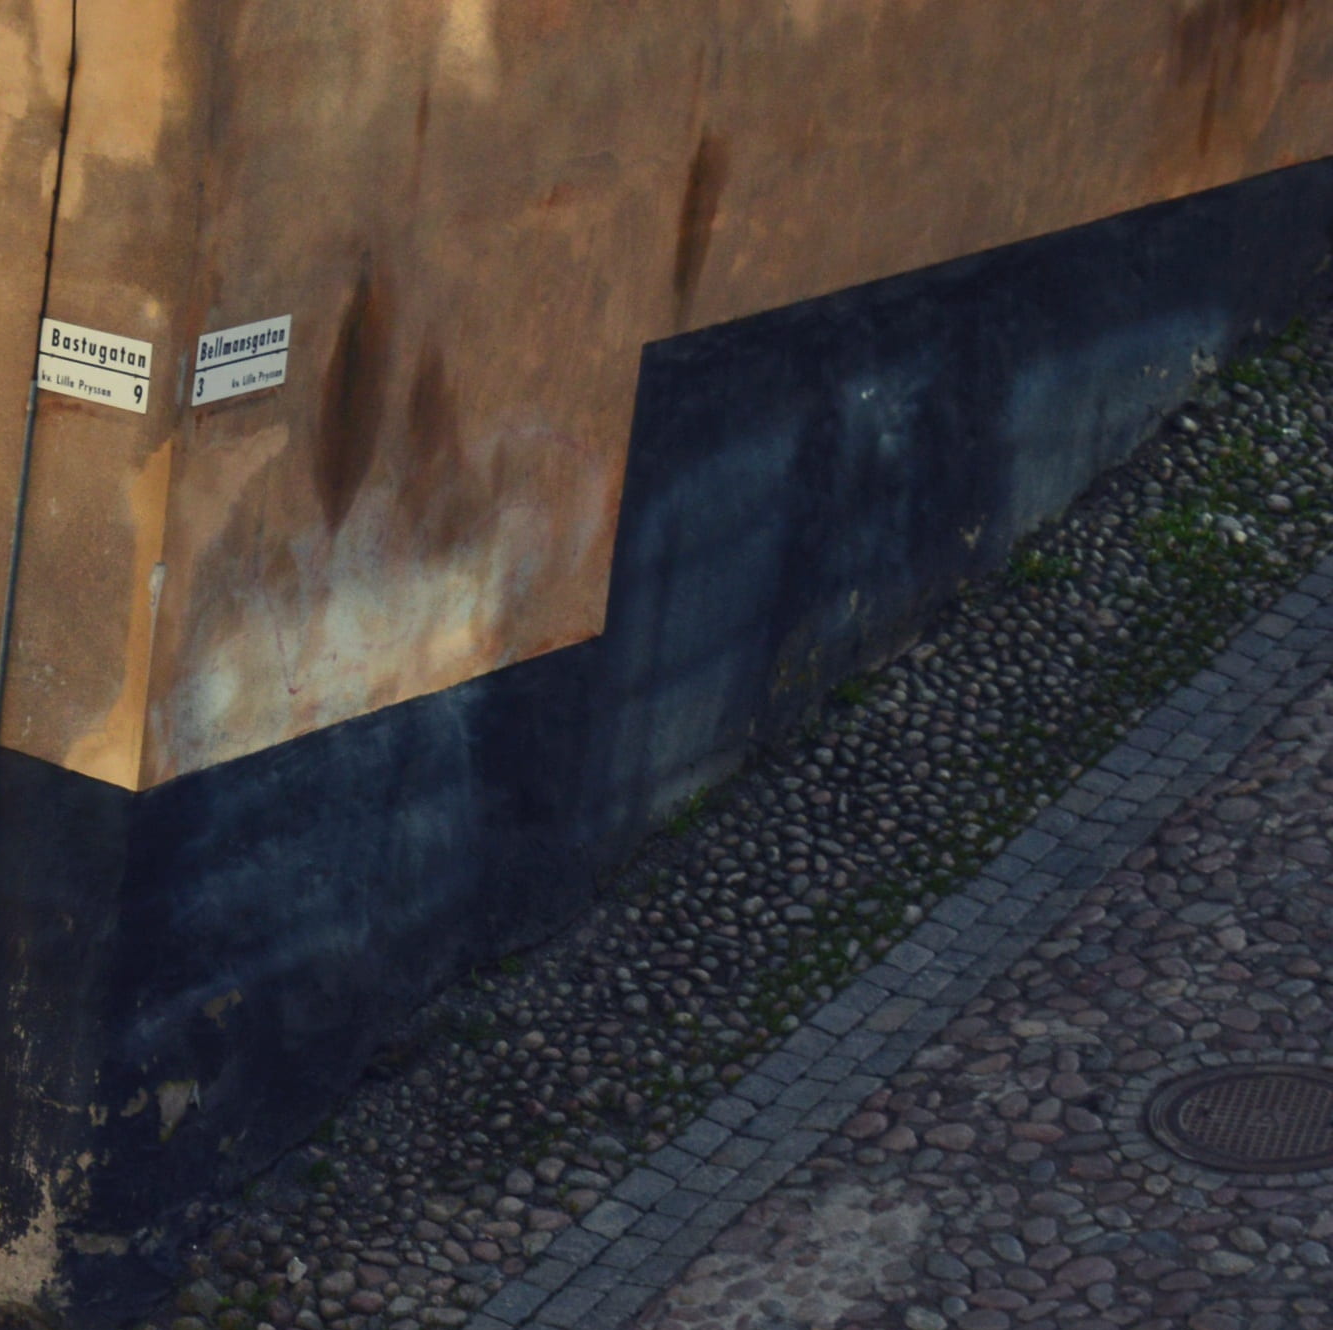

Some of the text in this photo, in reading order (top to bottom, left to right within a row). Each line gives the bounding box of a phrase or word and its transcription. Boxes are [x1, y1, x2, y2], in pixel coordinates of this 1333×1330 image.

[51, 328, 147, 368] Bastugatan
[200, 328, 285, 361] Bellmansgatan
[134, 385, 143, 404] 9
[196, 377, 205, 397] 3
